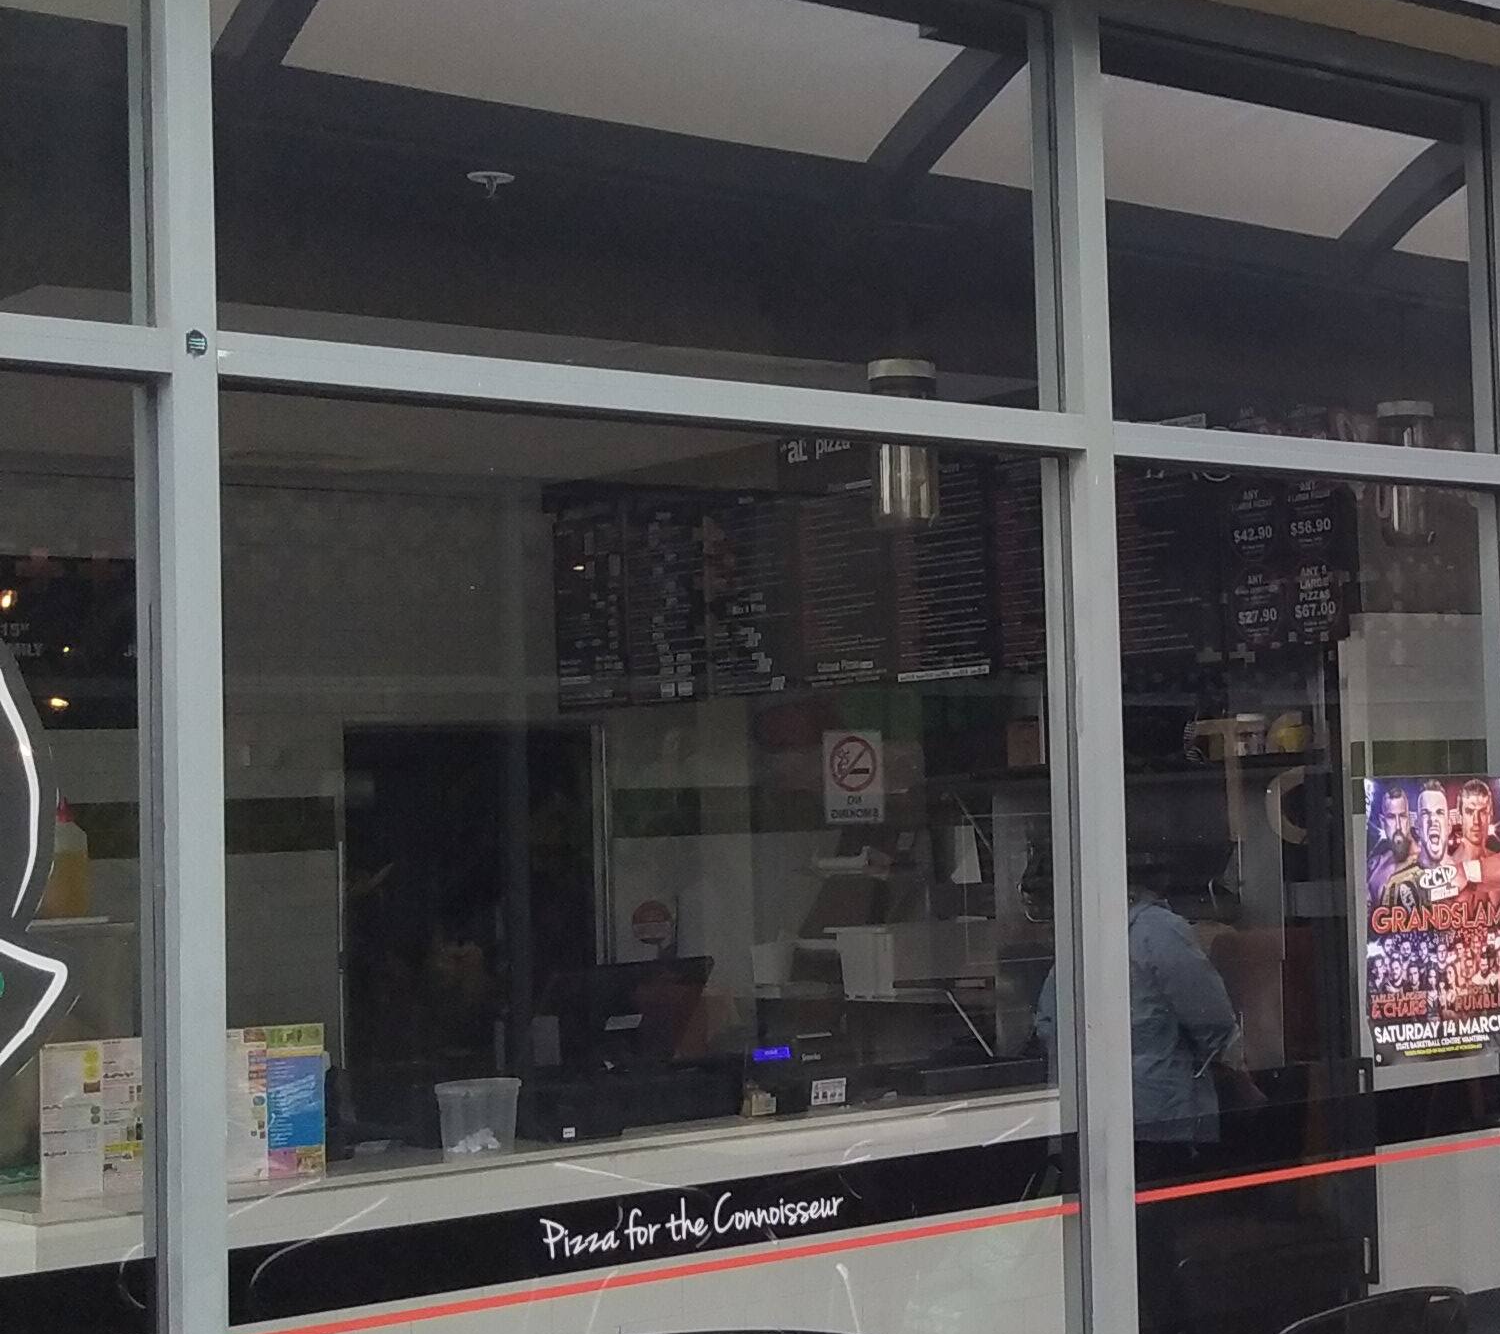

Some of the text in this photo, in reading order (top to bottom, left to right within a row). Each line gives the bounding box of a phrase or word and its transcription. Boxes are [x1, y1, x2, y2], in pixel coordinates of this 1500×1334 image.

[1300, 589, 1331, 602] PIZZAS
[1238, 607, 1278, 625] $27.90
[1294, 601, 1336, 618] $67.00
[1384, 999, 1427, 1017] CHAIRS
[1374, 1021, 1439, 1044] SATURDAY
[1443, 1019, 1456, 1036] 14
[540, 1192, 844, 1260] Pizza for the Connoisseur
